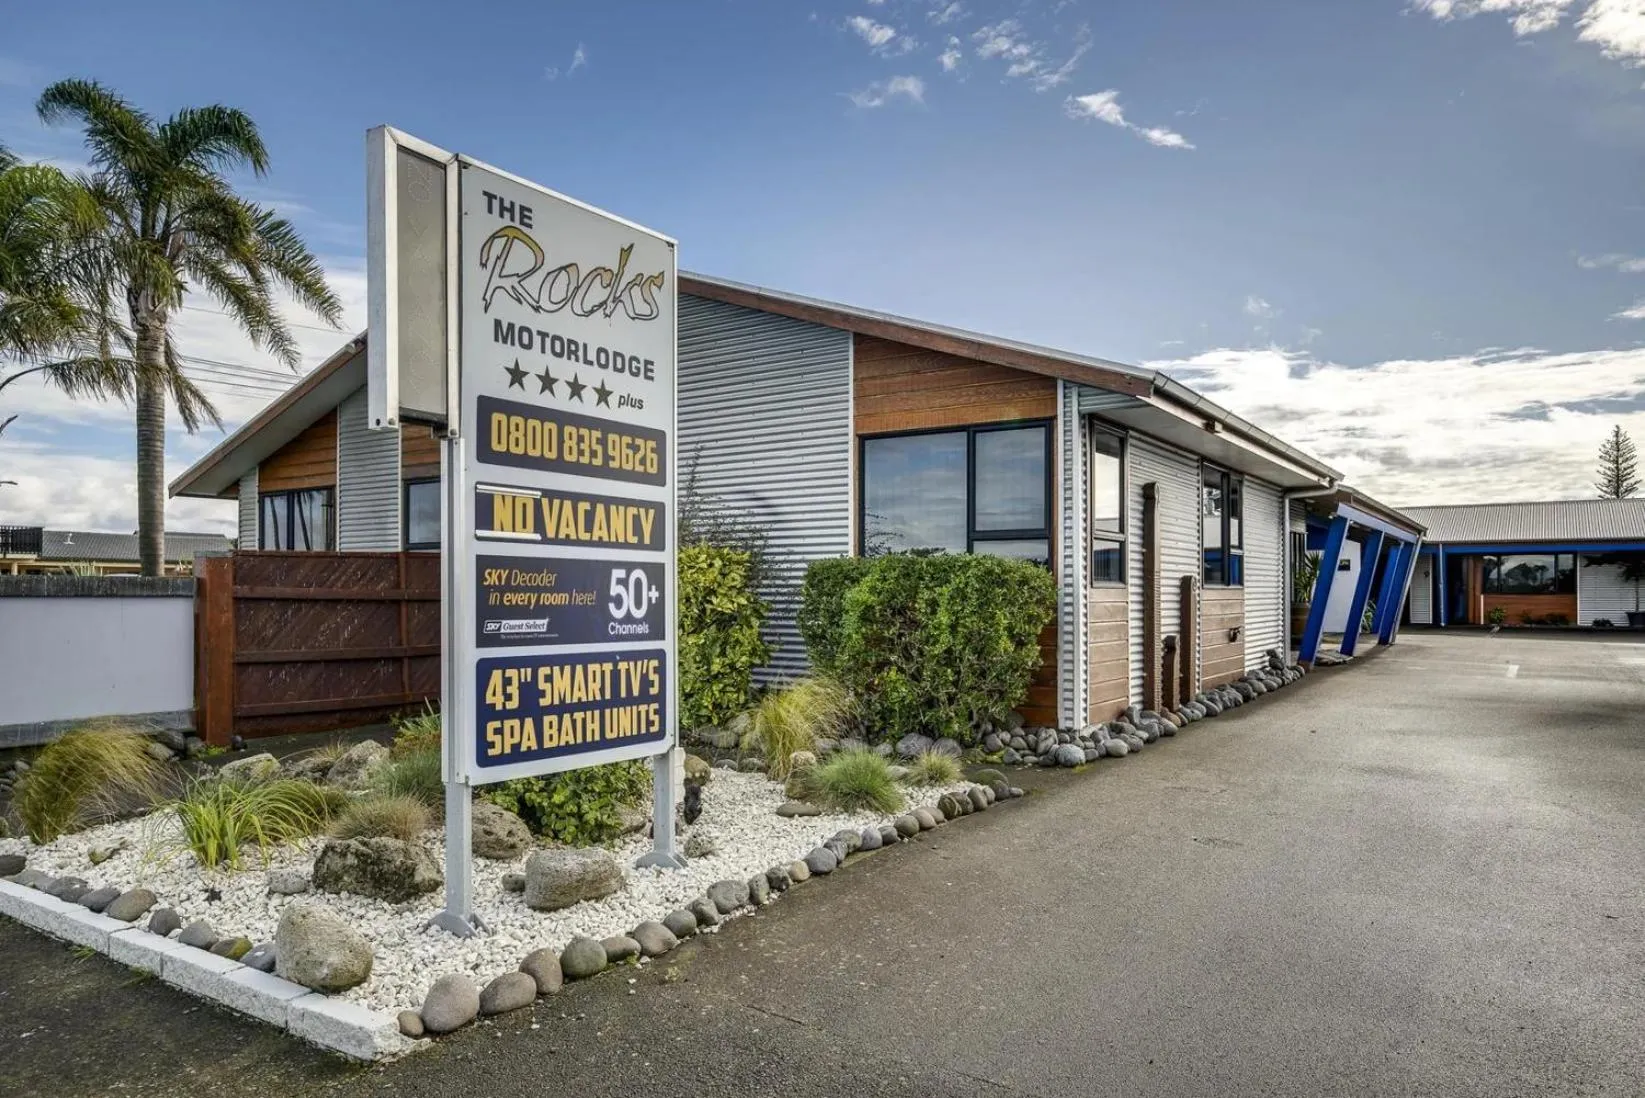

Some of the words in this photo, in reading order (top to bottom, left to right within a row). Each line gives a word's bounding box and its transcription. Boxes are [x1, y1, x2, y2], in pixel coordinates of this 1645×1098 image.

[482, 190, 533, 229] THE
[480, 225, 665, 320] Rocks
[493, 318, 655, 382] MOTORLODGE
[617, 393, 644, 410] plus
[491, 412, 558, 460] 0800
[563, 425, 603, 466] 835
[607, 433, 658, 474] 9626
[493, 493, 535, 534] NO
[541, 497, 656, 545] VACANCY
[483, 568, 510, 586] SKY
[511, 568, 558, 587] Decoder
[488, 588, 500, 605] in
[503, 592, 537, 610] every
[540, 591, 570, 606] room
[571, 588, 597, 606] here!
[608, 568, 659, 619] 50+
[524, 621, 546, 631] Select
[608, 622, 650, 636] Channels
[485, 667, 532, 711] 43"
[538, 662, 613, 707] SMART
[617, 659, 660, 698] TV'S
[486, 717, 538, 756] SPA
[543, 709, 600, 749] BATH
[604, 702, 660, 740] UNITS
